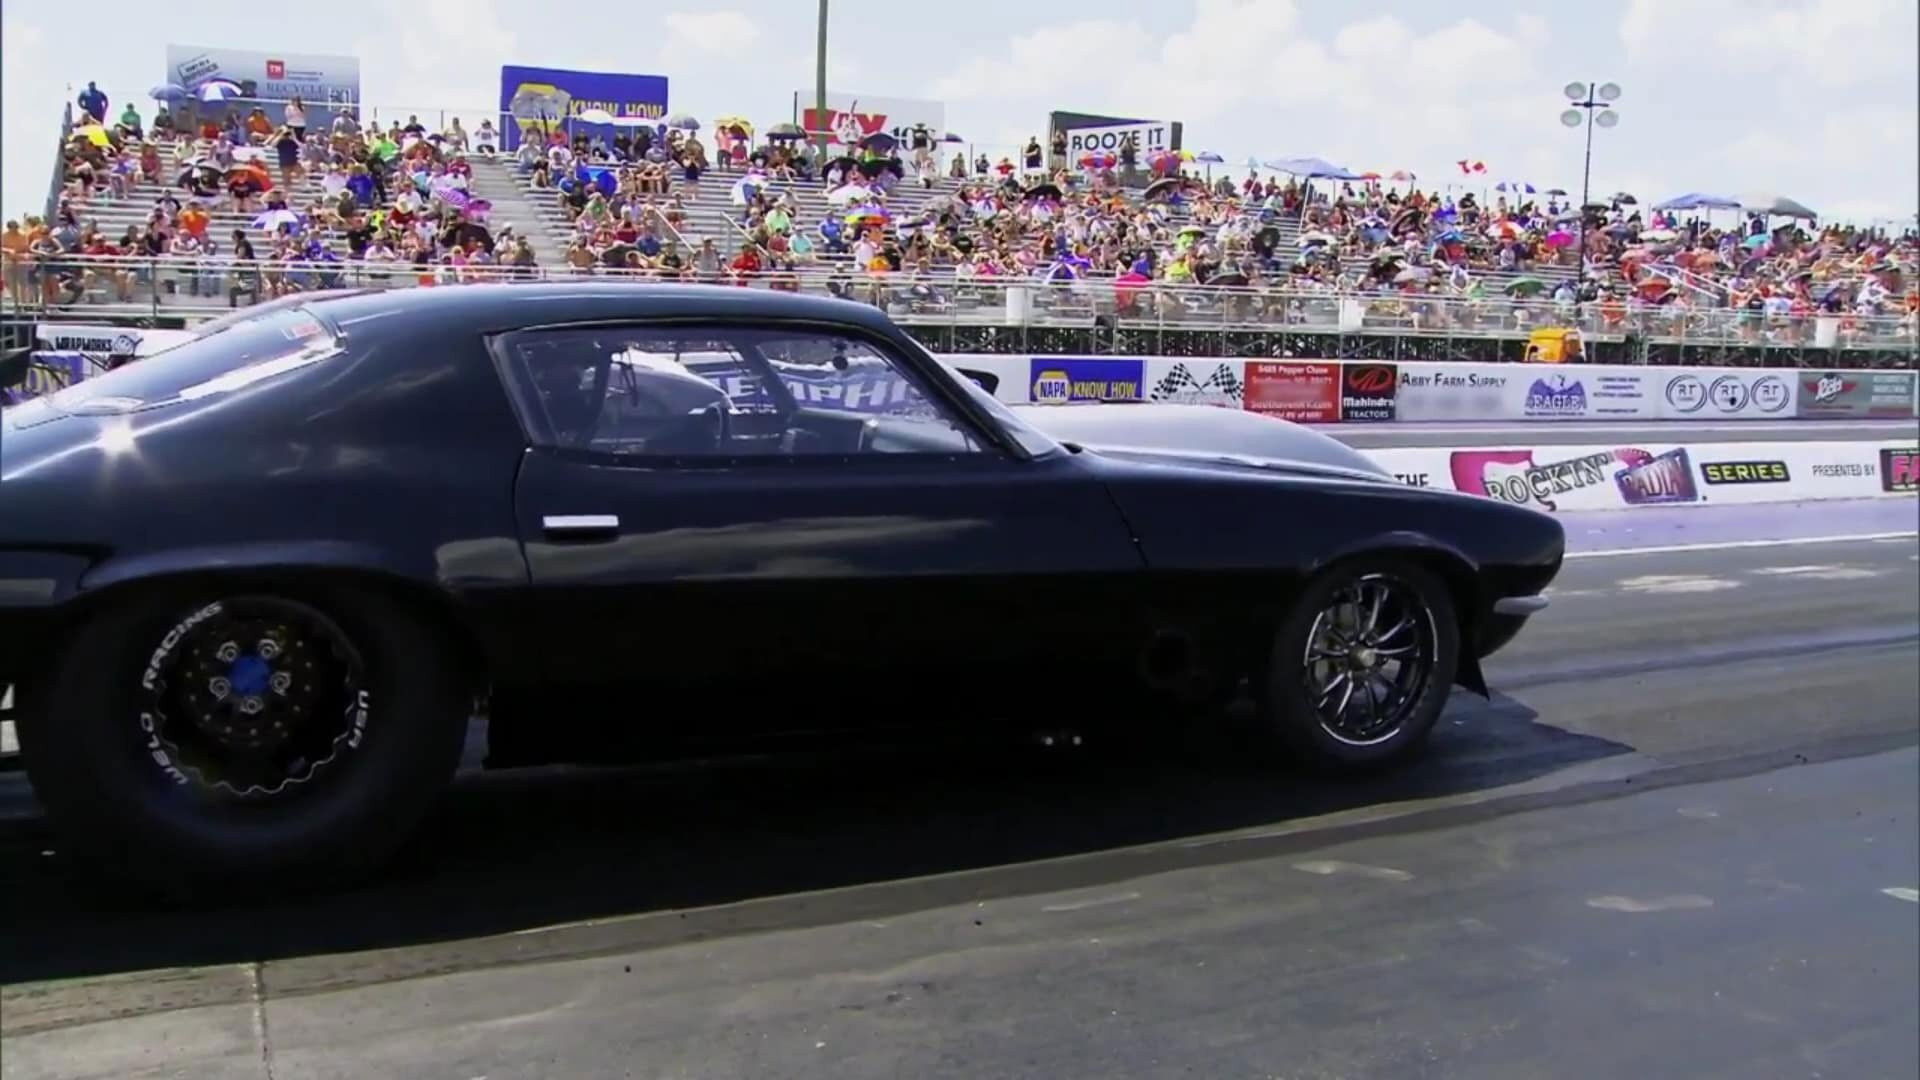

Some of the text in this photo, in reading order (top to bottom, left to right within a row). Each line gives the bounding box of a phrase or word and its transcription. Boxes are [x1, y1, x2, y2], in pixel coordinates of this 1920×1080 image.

[569, 100, 617, 118] KNOW
[624, 103, 664, 120] HOW
[1071, 127, 1165, 151] BOOZE IT
[1040, 381, 1136, 398] NAPA KNOW HOW
[1343, 397, 1395, 407] Mahindra
[1533, 395, 1582, 409] EAGLE
[1705, 464, 1785, 480] SERIES
[1810, 465, 1861, 476] PRESENTED
[140, 601, 221, 784] WELD RACING
[348, 690, 369, 748] USA
